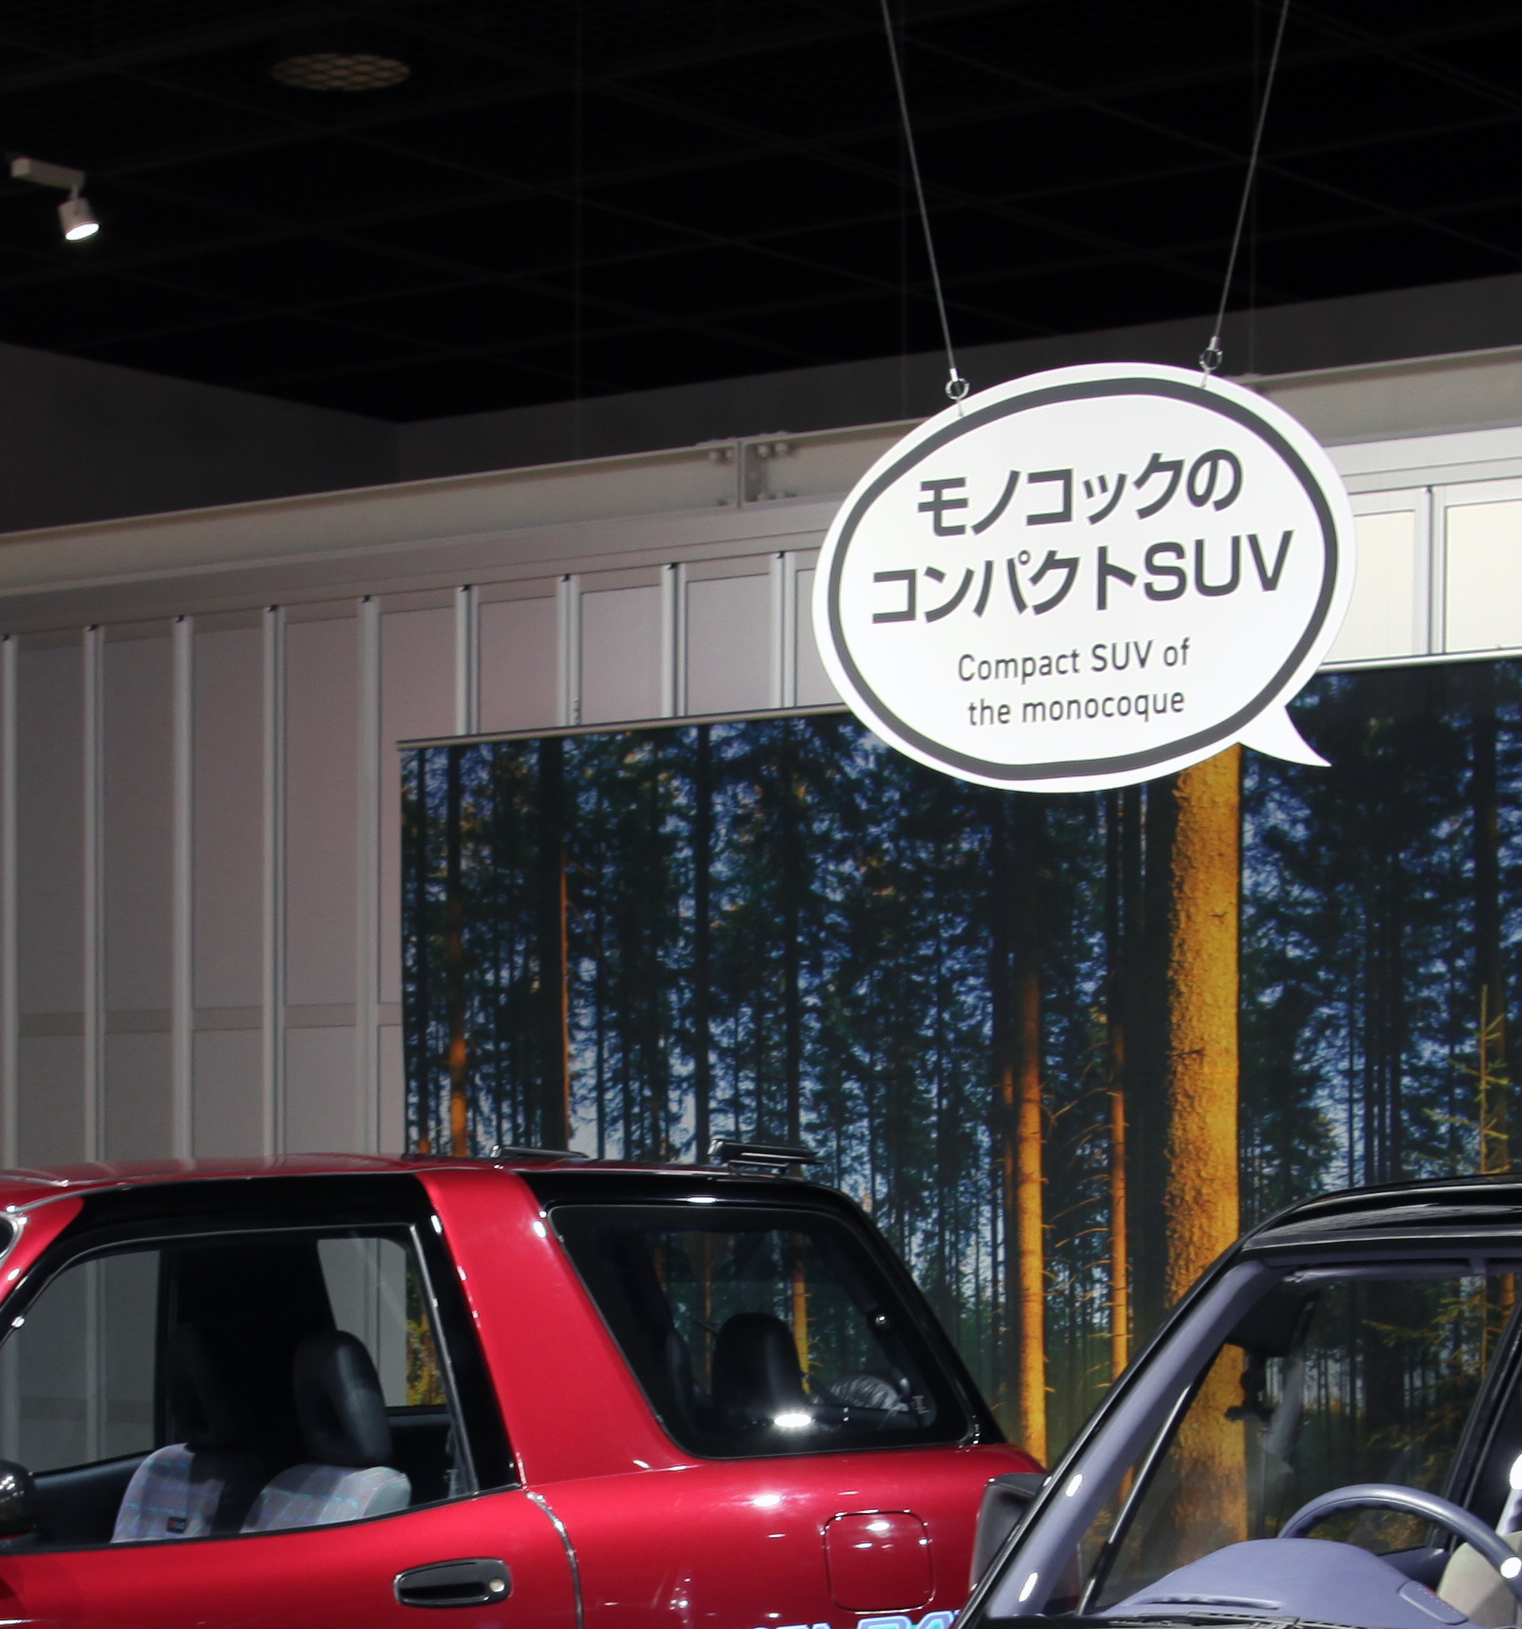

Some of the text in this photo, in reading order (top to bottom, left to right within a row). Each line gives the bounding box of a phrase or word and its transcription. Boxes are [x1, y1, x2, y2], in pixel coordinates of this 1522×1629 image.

[917, 449, 1242, 537] モノコックの
[872, 530, 1294, 624] コンパクトSUV
[958, 638, 1191, 685] Compact SUV of
[969, 690, 1185, 727] the monocoque
